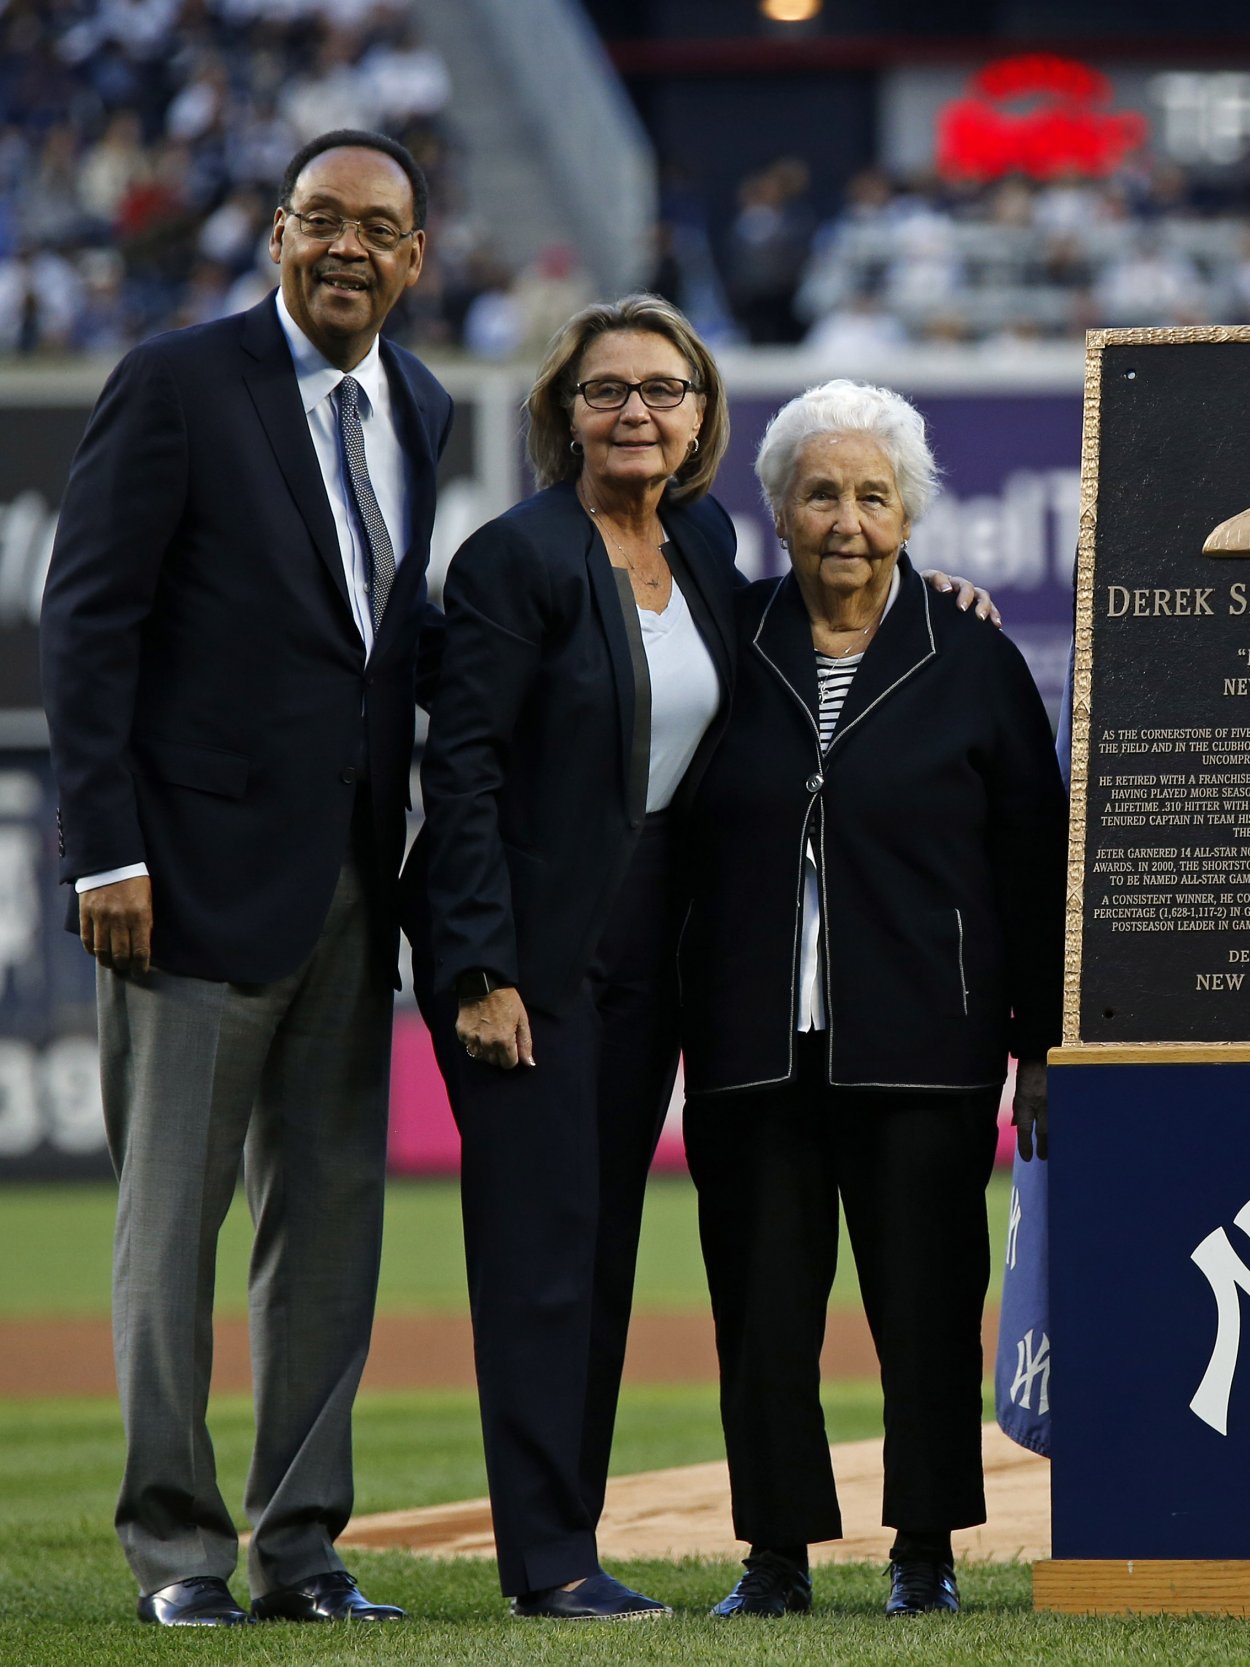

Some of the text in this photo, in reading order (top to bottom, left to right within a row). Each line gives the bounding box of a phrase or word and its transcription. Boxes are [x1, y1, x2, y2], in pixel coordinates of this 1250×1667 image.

[1107, 584, 1214, 616] DEREK
[1102, 730, 1114, 739] AS
[1118, 729, 1137, 739] THE
[1141, 728, 1211, 738] CORNERSTONE
[1215, 728, 1228, 737] OF
[1098, 743, 1118, 752] THE
[1122, 743, 1148, 752] FIELD
[1151, 742, 1172, 752] AND
[1175, 742, 1185, 752] IN
[1189, 741, 1208, 751] THE
[1111, 788, 1146, 798] HAVING
[1150, 788, 1186, 797] PLAYED
[1190, 787, 1218, 797] MORE
[1104, 802, 1111, 812] A
[1115, 802, 1158, 811] LIFETIME
[1162, 801, 1181, 810] .310
[1184, 801, 1219, 810] HITTER
[1223, 800, 1248, 810] WITH
[1096, 848, 1124, 858] JETER
[1127, 847, 1177, 858] GARNERED
[1181, 847, 1190, 856] 14
[1194, 846, 1237, 856] ALL-STAR
[1093, 862, 1134, 872] AWARDS.
[1138, 861, 1148, 870] IN
[1152, 861, 1175, 872] 2000,
[1179, 861, 1198, 870] THE
[1102, 895, 1108, 904] A
[1112, 894, 1172, 904] CONSISTENT
[1175, 893, 1216, 904] WINNER,
[1220, 893, 1233, 902] HE
[1094, 907, 1155, 918] PERCENTAGE
[1159, 906, 1226, 918] (1,628-1,117-2)
[1230, 906, 1240, 916] IN
[1112, 921, 1174, 931] POSTSEASON
[1178, 920, 1214, 930] LEADER
[1218, 920, 1228, 929] IN
[1196, 974, 1244, 990] NEW
